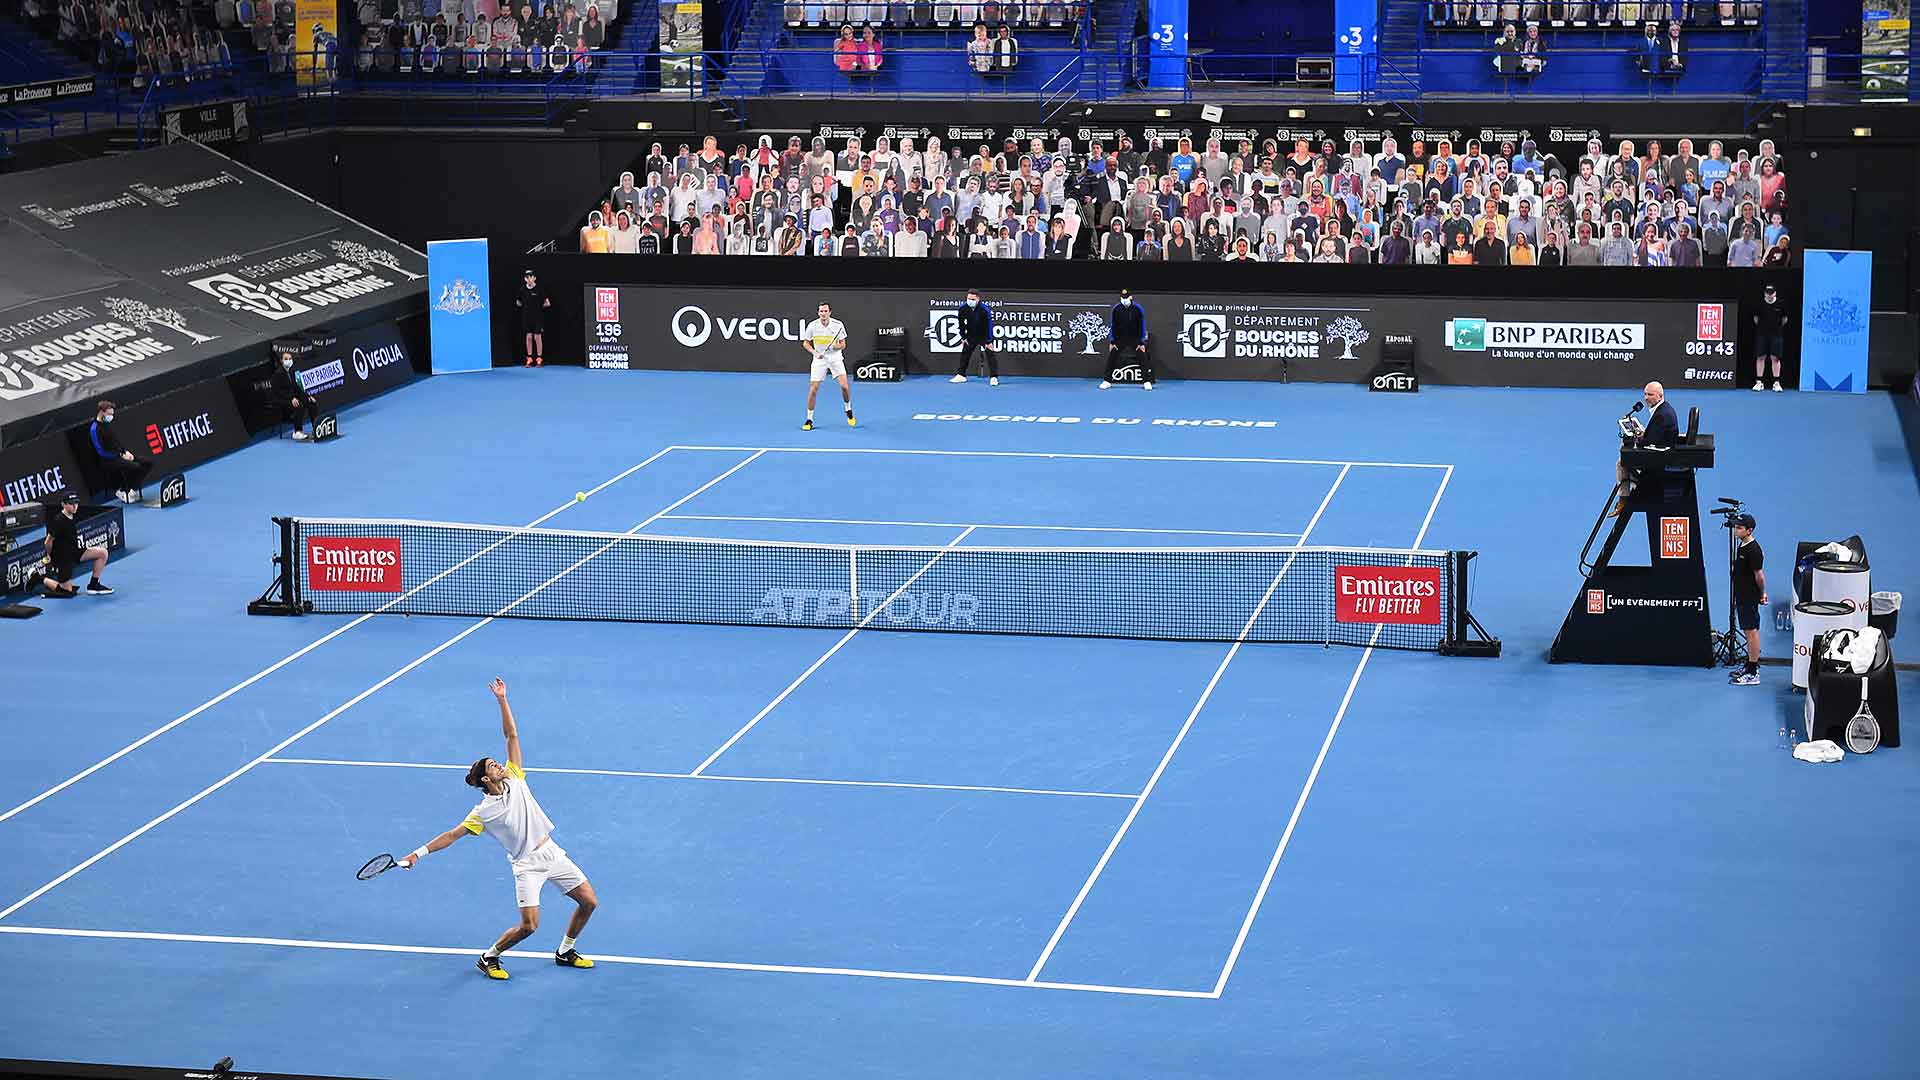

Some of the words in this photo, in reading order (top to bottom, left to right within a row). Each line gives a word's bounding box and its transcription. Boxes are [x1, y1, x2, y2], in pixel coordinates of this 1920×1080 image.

[1184, 303, 1223, 311] Partenaire
[1225, 305, 1259, 313] principal
[1701, 309, 1719, 320] TEN
[596, 323, 622, 336] 196
[716, 317, 807, 341] VEOLI
[1234, 315, 1320, 327] DÉPARTEMENT
[1492, 326, 1536, 344] BNP
[1542, 327, 1633, 345] PARIBAS
[1702, 325, 1718, 336] NIS
[13, 322, 137, 366] BOUCHES
[1685, 341, 1735, 356] 00:43
[365, 343, 404, 370] VEOLIA
[1491, 349, 1501, 358] La
[1503, 350, 1534, 360] banque
[1536, 350, 1555, 359] d'un
[1557, 351, 1586, 360] monde
[1588, 351, 1602, 361] qui
[1603, 351, 1635, 361] change
[302, 371, 315, 386] BNP
[315, 362, 341, 382] PARIBAS
[1696, 370, 1734, 380] EIFFAGE
[911, 413, 1082, 424] BOUCHES
[1089, 417, 1143, 425] DU
[162, 411, 214, 450] EIFFAGE
[5, 465, 66, 507] EIFFAGE
[1665, 523, 1684, 535] TEN
[312, 545, 397, 567] Emirates
[1666, 541, 1684, 553] NIS
[325, 566, 344, 582] FLY
[346, 567, 385, 584] BETTER
[1341, 575, 1436, 597] Emirates
[751, 587, 851, 622] ATP
[859, 590, 981, 626] TOUR
[1355, 597, 1376, 614] FLY
[1378, 598, 1421, 615] BETTER
